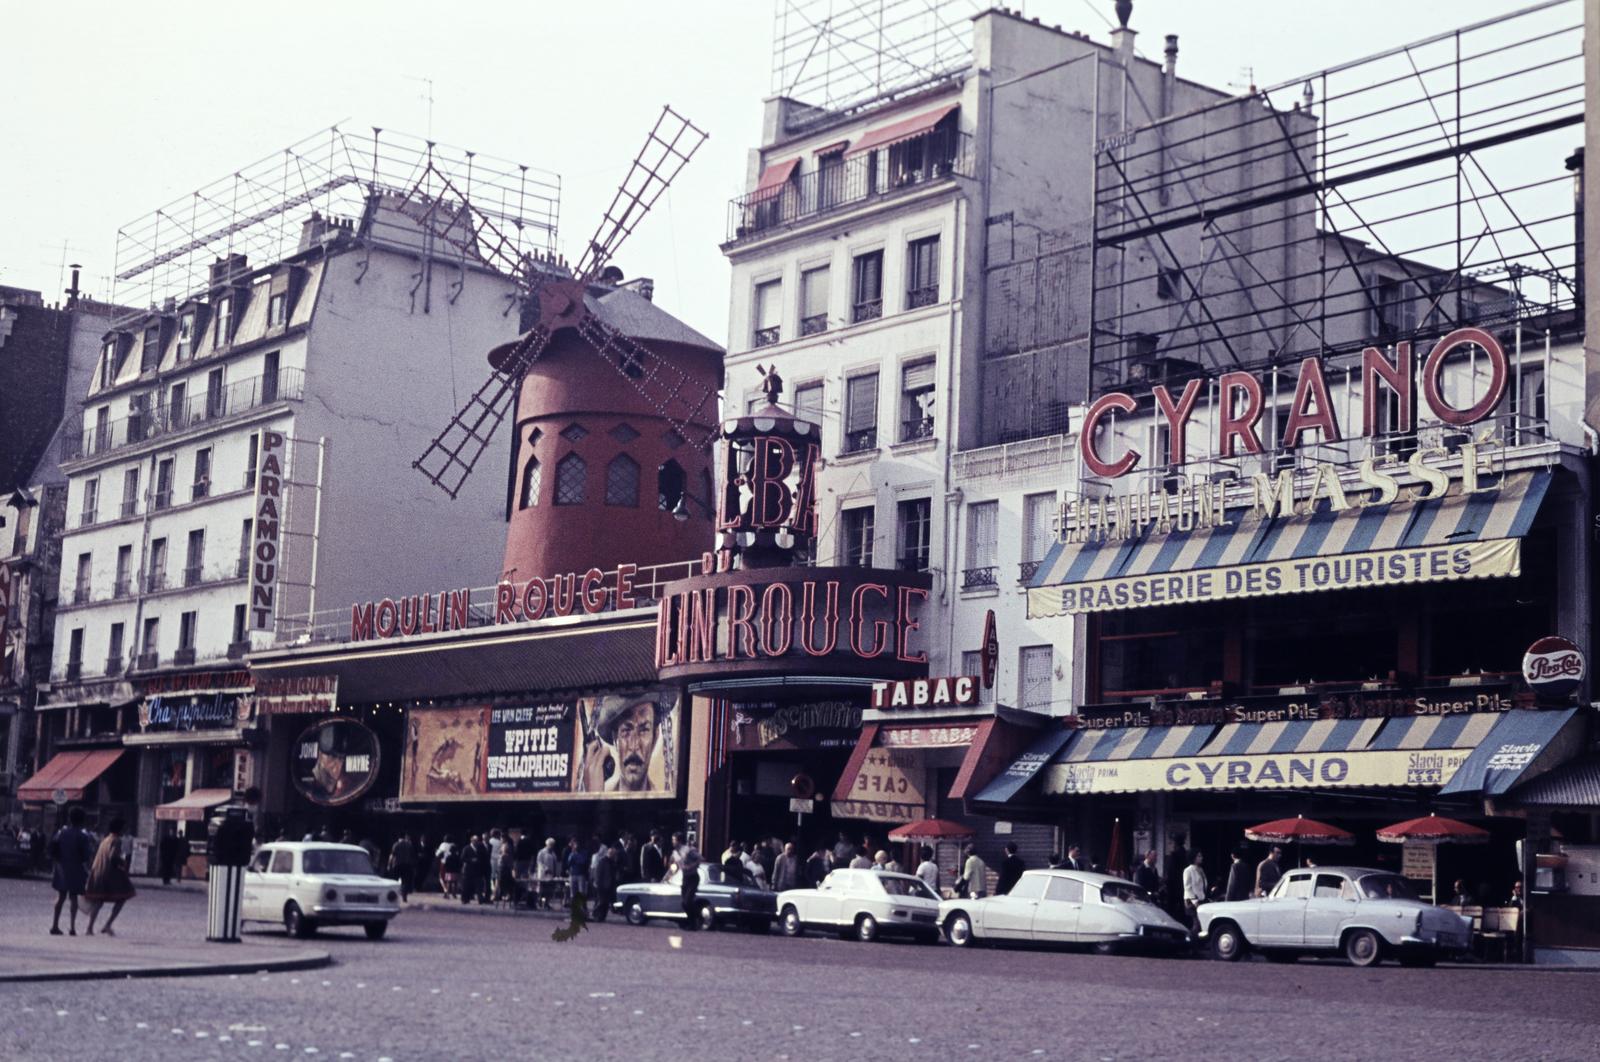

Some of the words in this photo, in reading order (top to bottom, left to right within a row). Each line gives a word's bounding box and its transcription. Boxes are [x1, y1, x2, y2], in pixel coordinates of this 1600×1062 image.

[1081, 327, 1509, 478] CYRANO
[1057, 478, 1234, 545] CHAMPAGNE
[252, 431, 283, 629] PARAMOUNT
[702, 551, 733, 575] DU
[1061, 572, 1213, 612] BRASSERIE
[1225, 566, 1283, 595] DES
[1294, 548, 1473, 587] TOURISTES
[351, 587, 470, 642] MOULIN
[495, 563, 637, 625] ROUGE
[726, 581, 929, 664] ROUGE
[872, 677, 972, 706] TABAC
[1415, 697, 1474, 716] Super
[1476, 694, 1513, 712] Pils
[148, 694, 235, 731] Chapigneulles
[1076, 713, 1121, 730] Super
[1124, 711, 1150, 728] Pils
[1234, 705, 1286, 723] Super
[1288, 703, 1319, 721] Pils
[300, 742, 318, 759] JOHN
[514, 725, 558, 753] PITIÉ
[346, 755, 370, 773] WAYNE
[498, 753, 569, 779] SALOPARDS
[1098, 767, 1119, 778] PRIMA
[1165, 758, 1349, 787] CYRANO
[1408, 753, 1444, 768] Slavia
